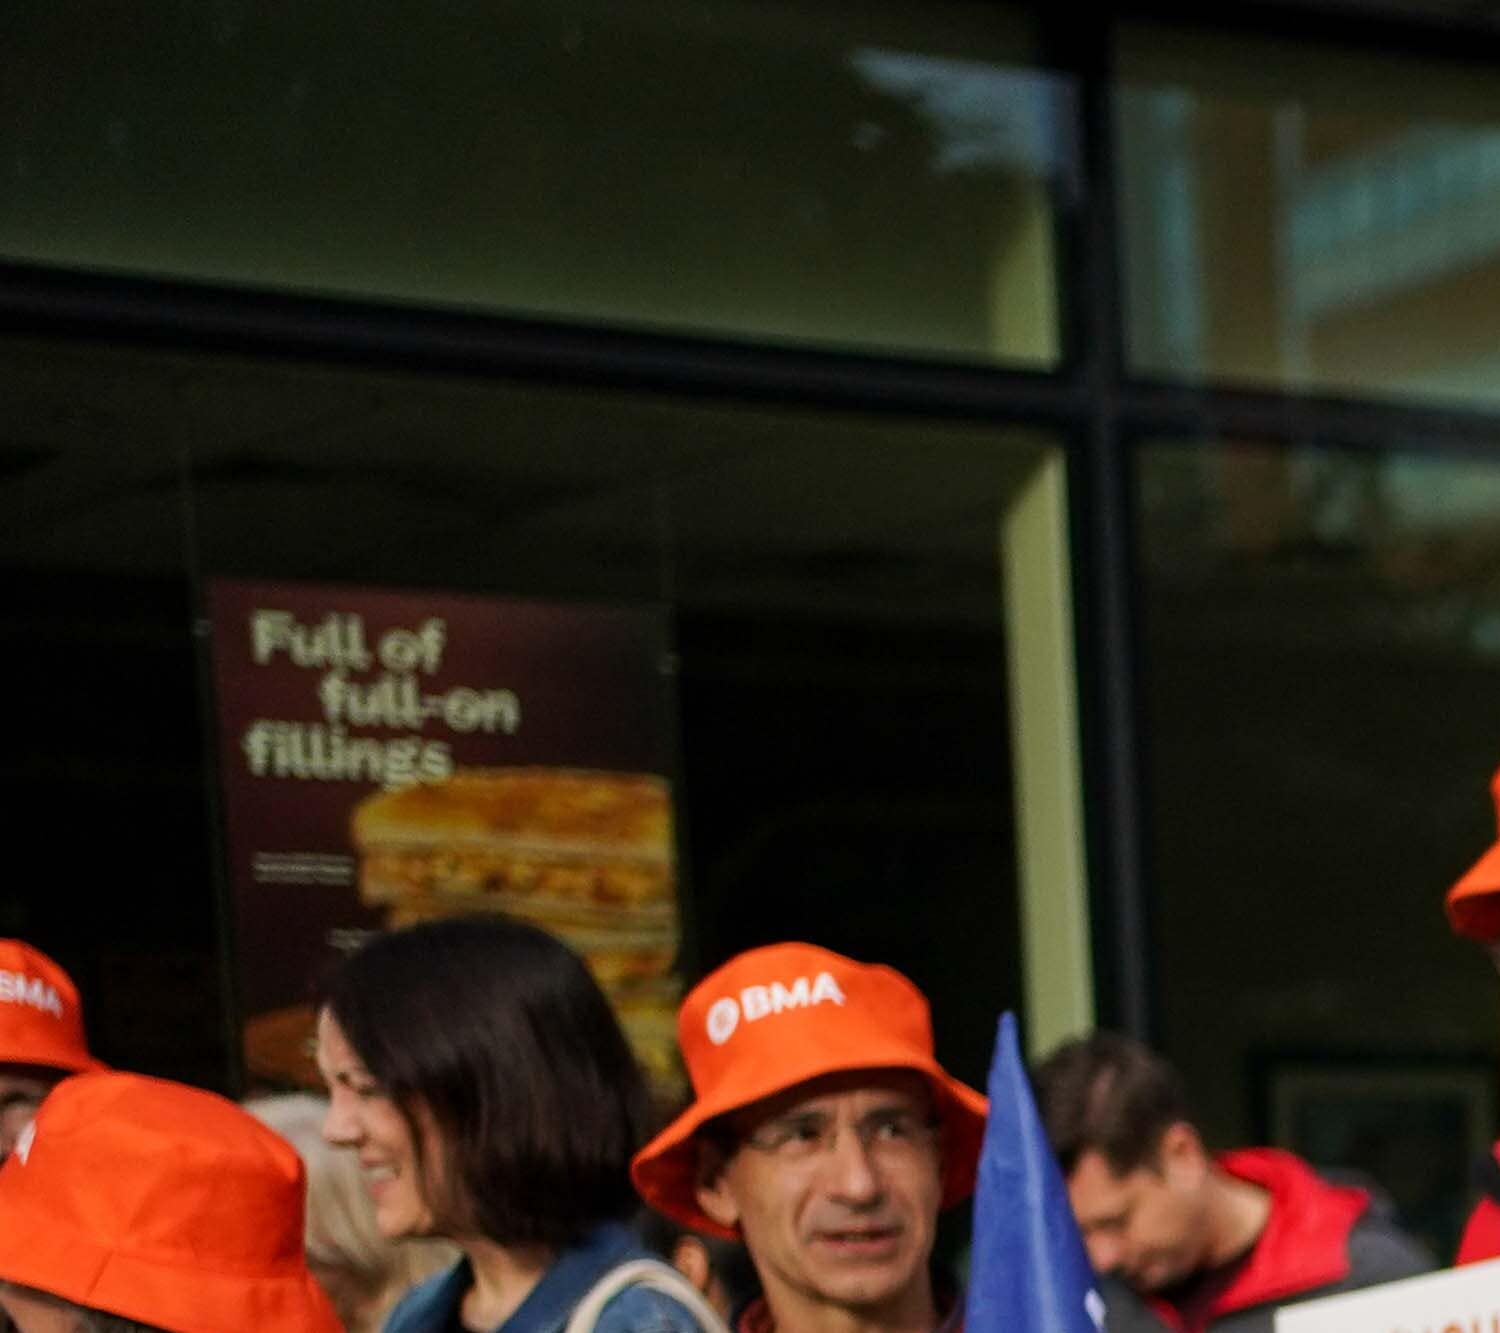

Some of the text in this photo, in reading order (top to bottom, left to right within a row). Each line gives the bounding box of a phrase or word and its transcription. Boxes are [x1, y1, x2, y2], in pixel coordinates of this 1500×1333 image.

[252, 609, 448, 674] Full of
[319, 668, 521, 734] full-on
[242, 719, 453, 792] fillings
[740, 971, 846, 1023] BMA
